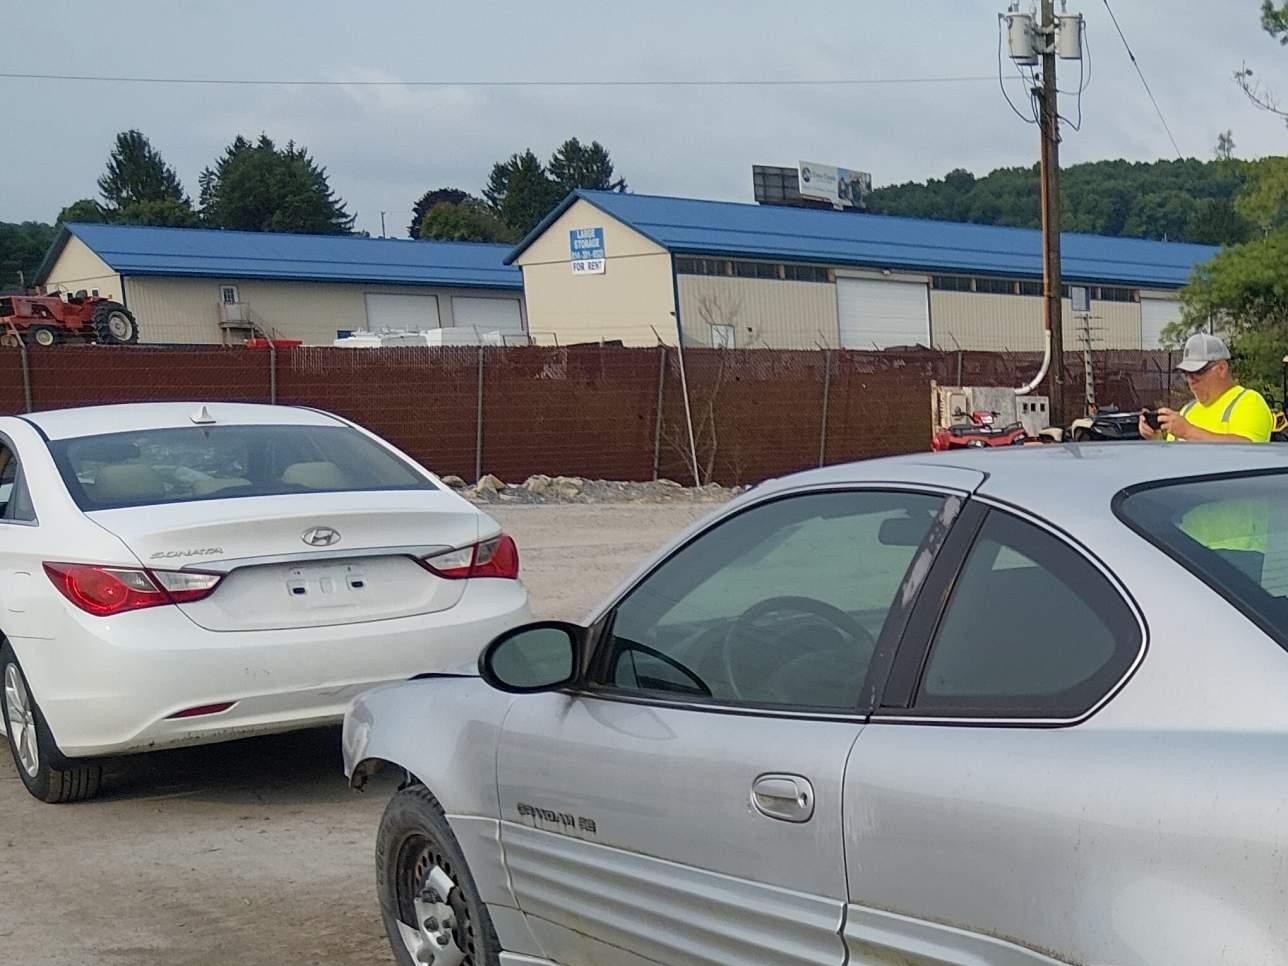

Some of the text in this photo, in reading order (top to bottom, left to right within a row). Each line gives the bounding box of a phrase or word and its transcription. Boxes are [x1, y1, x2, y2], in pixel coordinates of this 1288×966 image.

[574, 238, 601, 249] STORAGE
[573, 261, 602, 271] FOR RENT
[150, 546, 224, 559] SONATA
